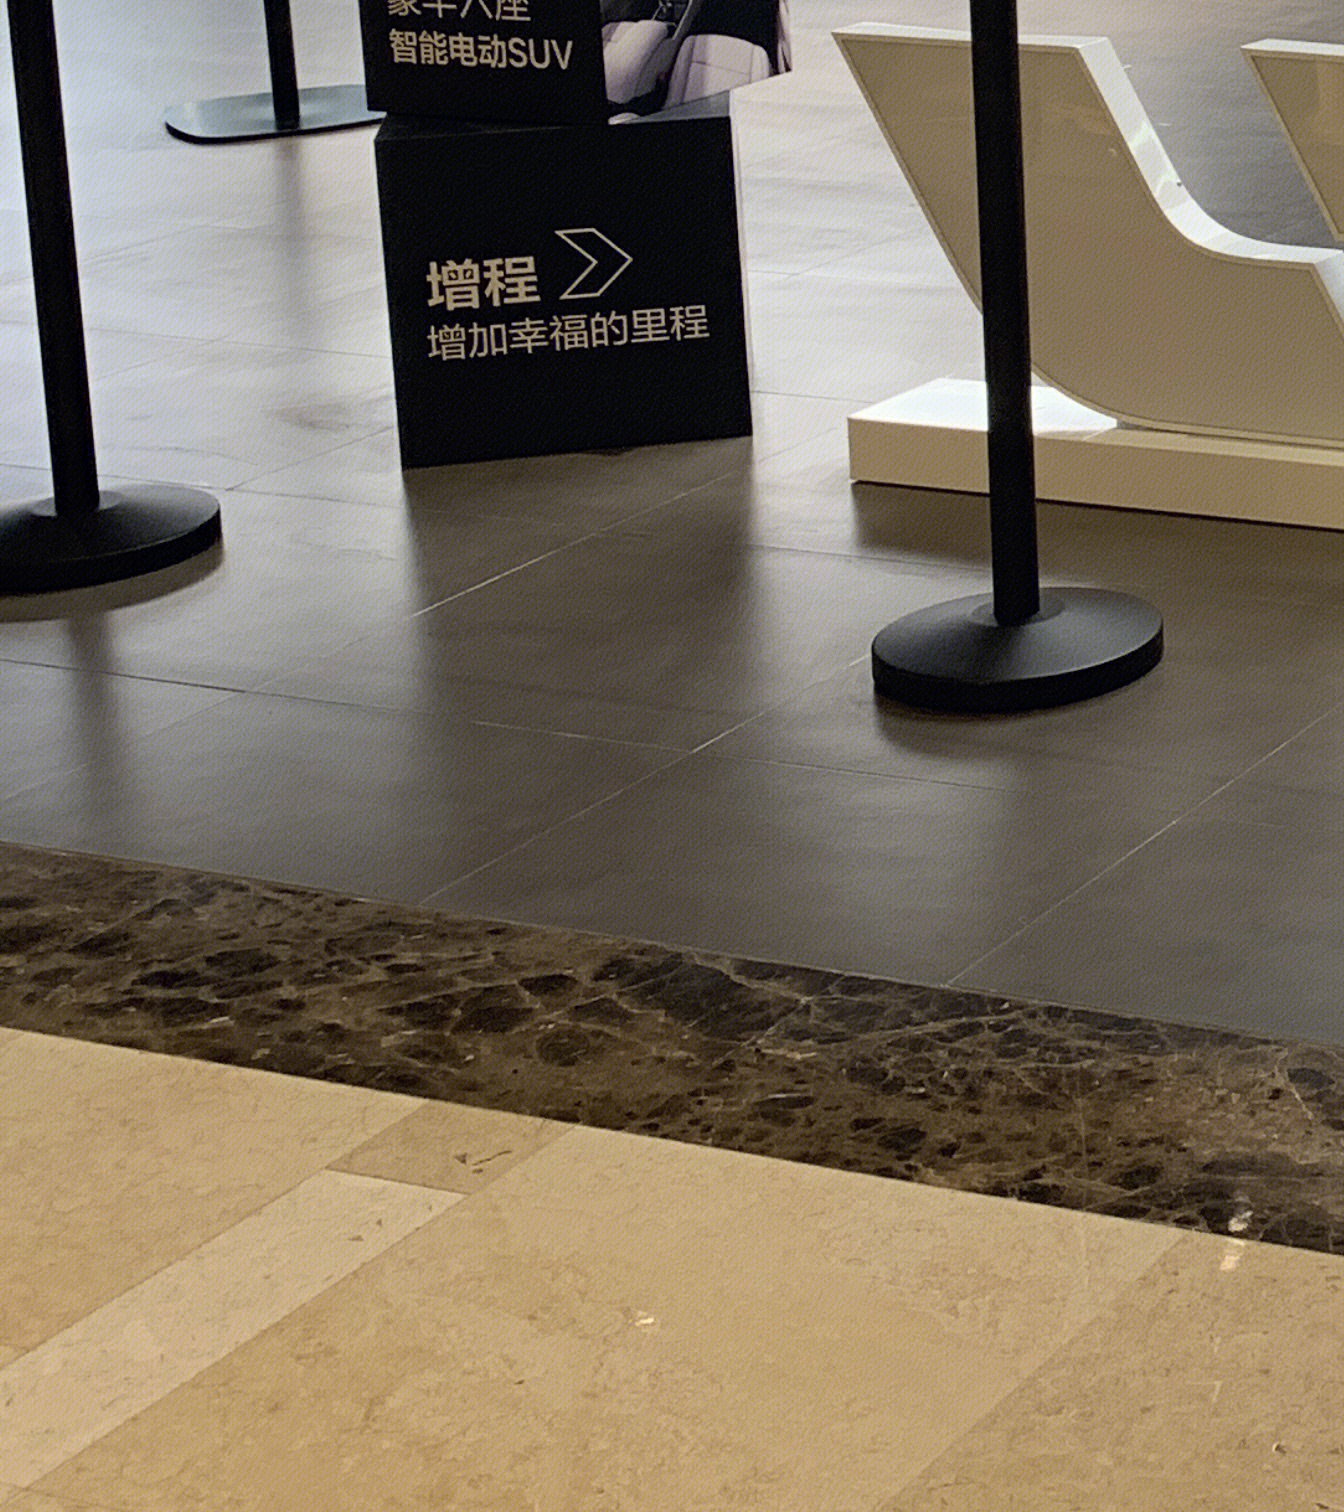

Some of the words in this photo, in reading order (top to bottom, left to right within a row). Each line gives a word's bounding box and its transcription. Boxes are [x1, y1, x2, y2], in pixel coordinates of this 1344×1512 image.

[389, 28, 573, 70] 智能电动SUV
[426, 256, 541, 311] 增程
[427, 304, 710, 361] 增加幸福的里程
